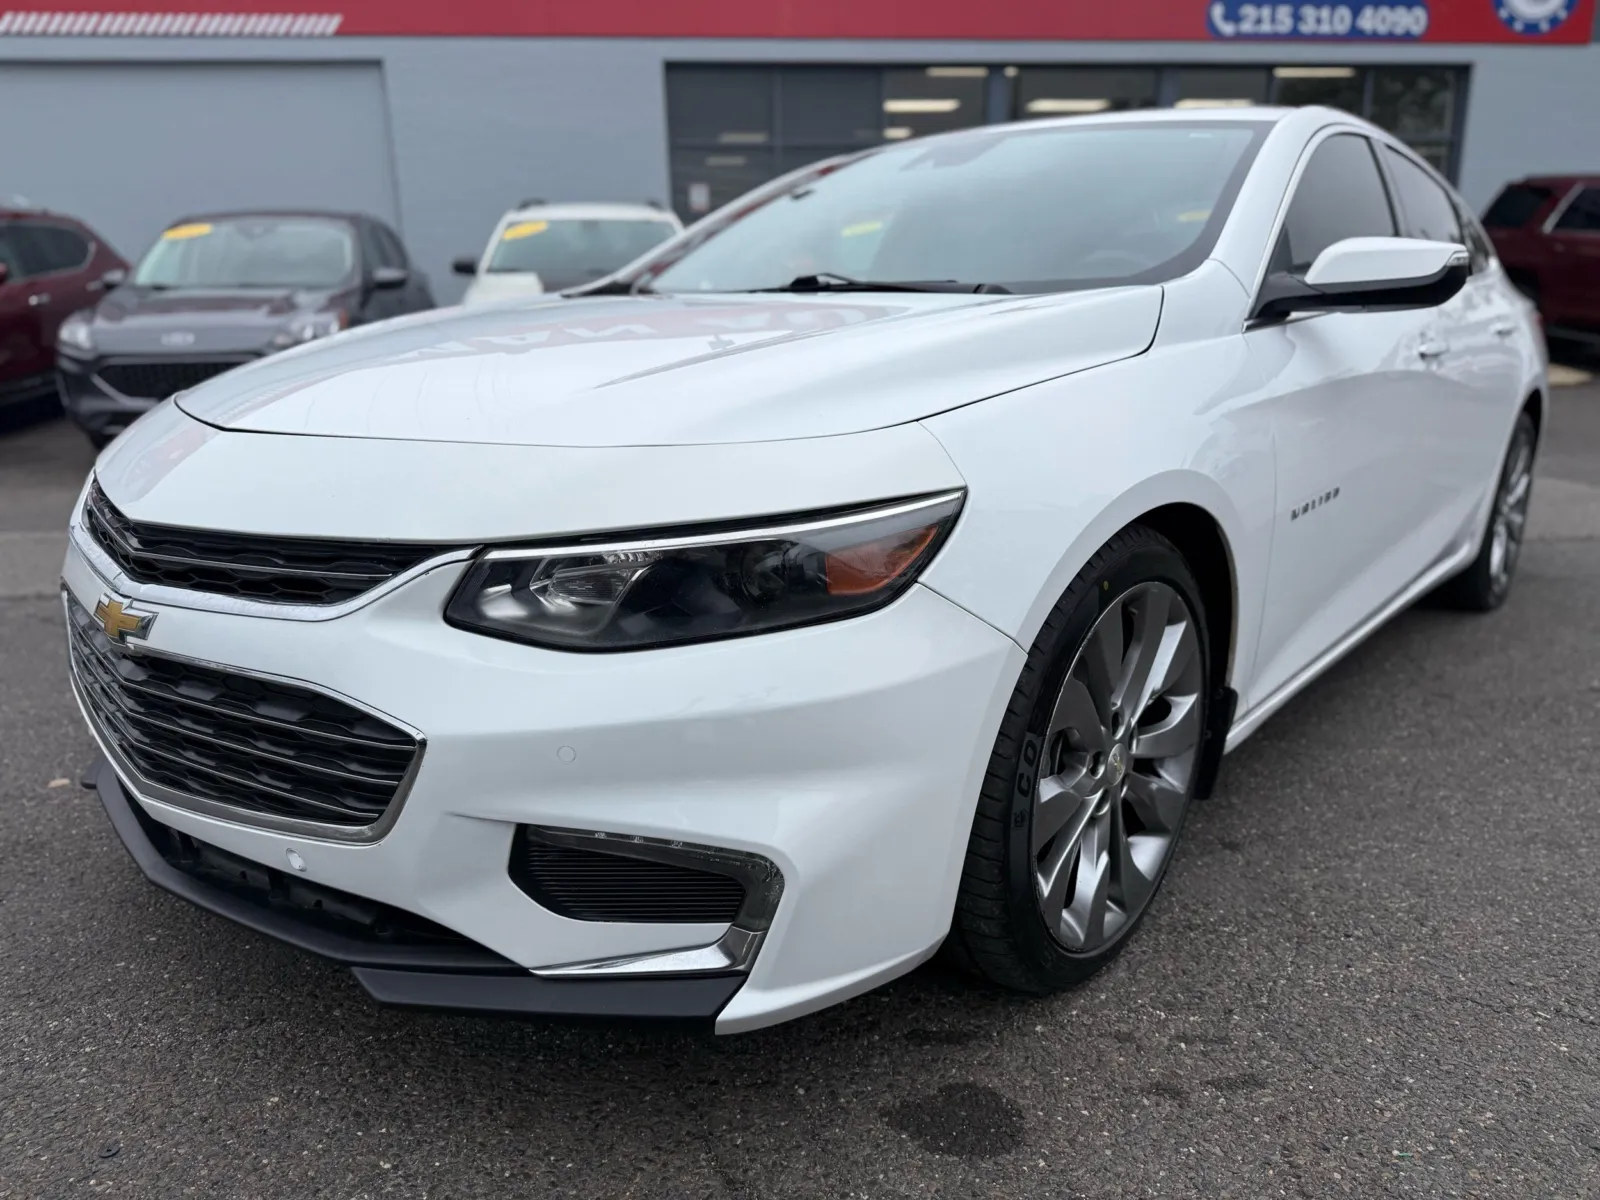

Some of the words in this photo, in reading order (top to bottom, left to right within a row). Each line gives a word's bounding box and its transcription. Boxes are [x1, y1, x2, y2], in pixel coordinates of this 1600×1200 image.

[1238, 4, 1293, 35] 215
[1297, 5, 1352, 36] 310
[1355, 5, 1429, 36] 4090
